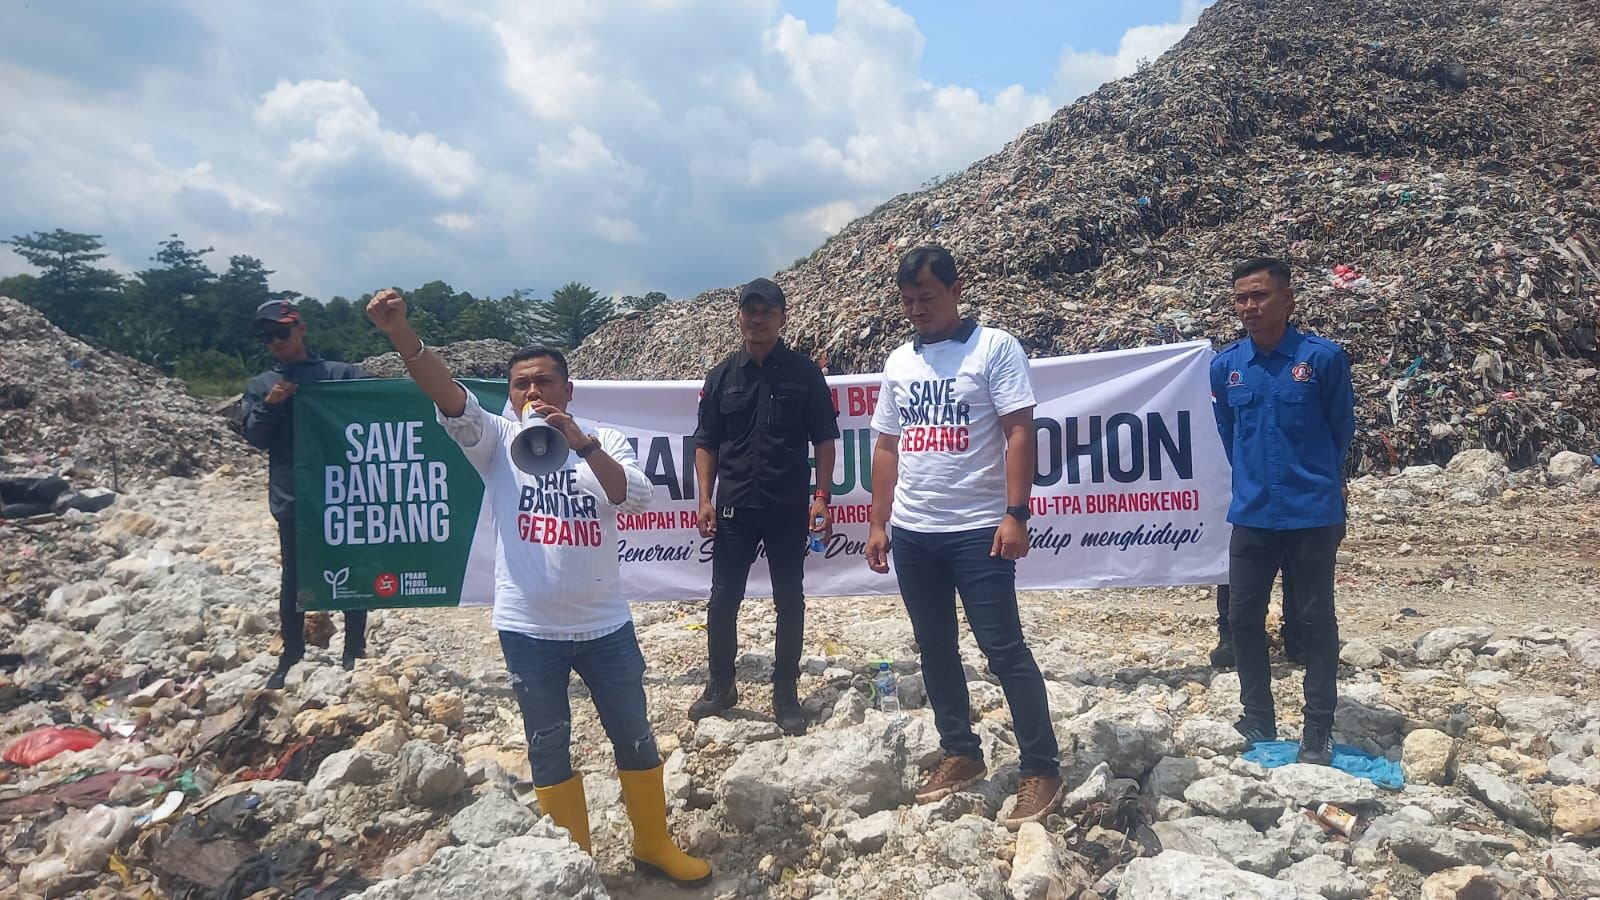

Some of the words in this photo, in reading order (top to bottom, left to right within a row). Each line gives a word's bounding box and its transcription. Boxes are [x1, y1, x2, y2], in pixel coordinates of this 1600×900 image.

[909, 378, 957, 406] SAVE
[899, 402, 970, 427] BANTAR
[345, 421, 425, 463] SAVE
[901, 426, 969, 452] GEBANG
[1032, 410, 1193, 487] OHON
[325, 461, 449, 504] BANTAR
[518, 485, 597, 519] BANTAR
[616, 511, 676, 531] SAMPAH
[1029, 495, 1082, 516] TU-TPA
[324, 502, 450, 546] GEBANG
[517, 513, 602, 547] GEBANG
[1028, 526, 1072, 555] idup
[1080, 522, 1204, 551] menghidupi
